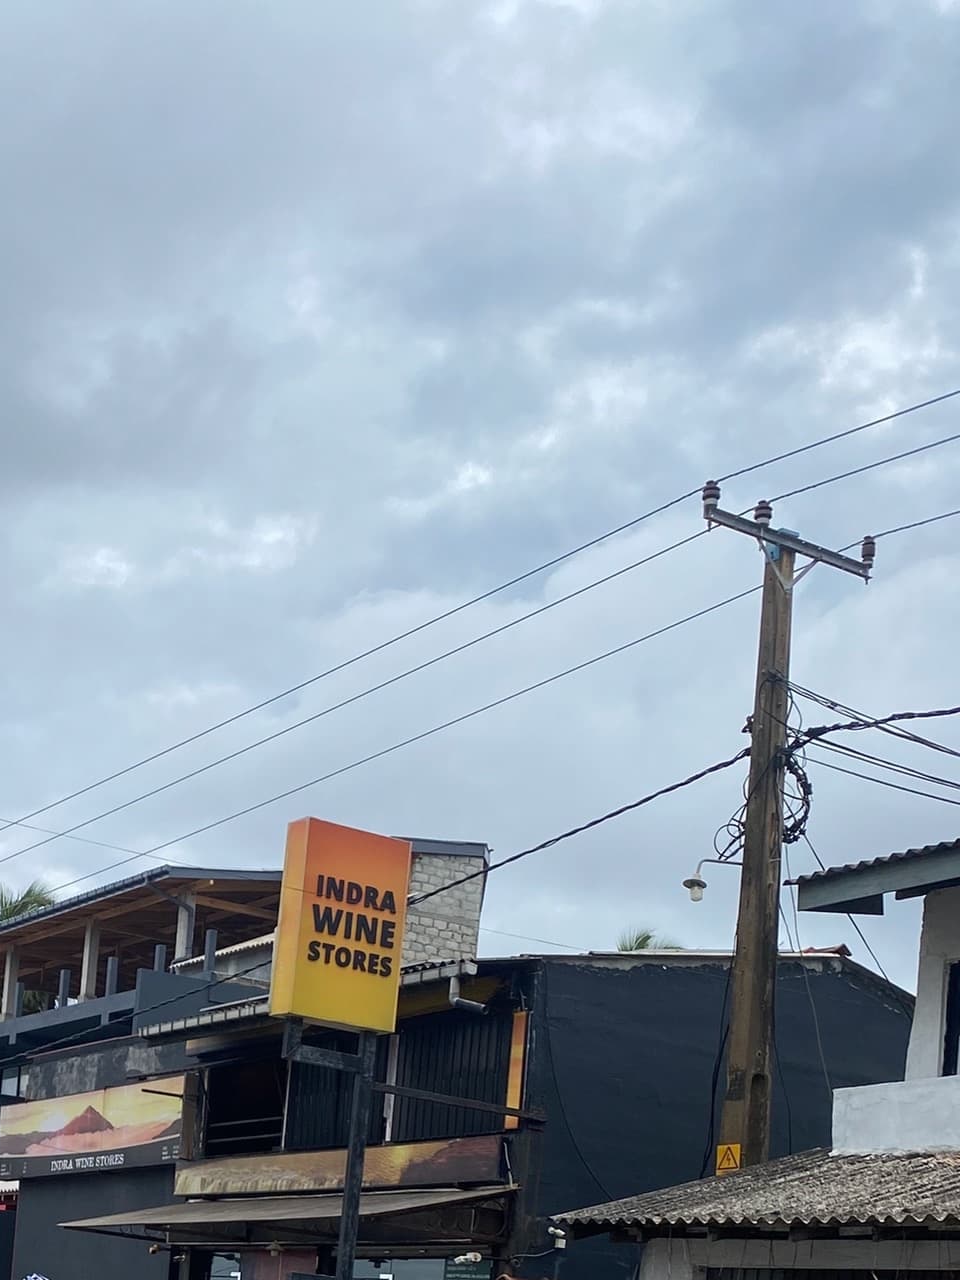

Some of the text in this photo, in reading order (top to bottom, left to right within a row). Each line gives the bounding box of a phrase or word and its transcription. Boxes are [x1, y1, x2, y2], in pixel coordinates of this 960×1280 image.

[316, 874, 396, 914] INDRA
[312, 904, 396, 949] WINE
[307, 940, 393, 977] STORES
[50, 1153, 125, 1171] INDRA WINE STORES
